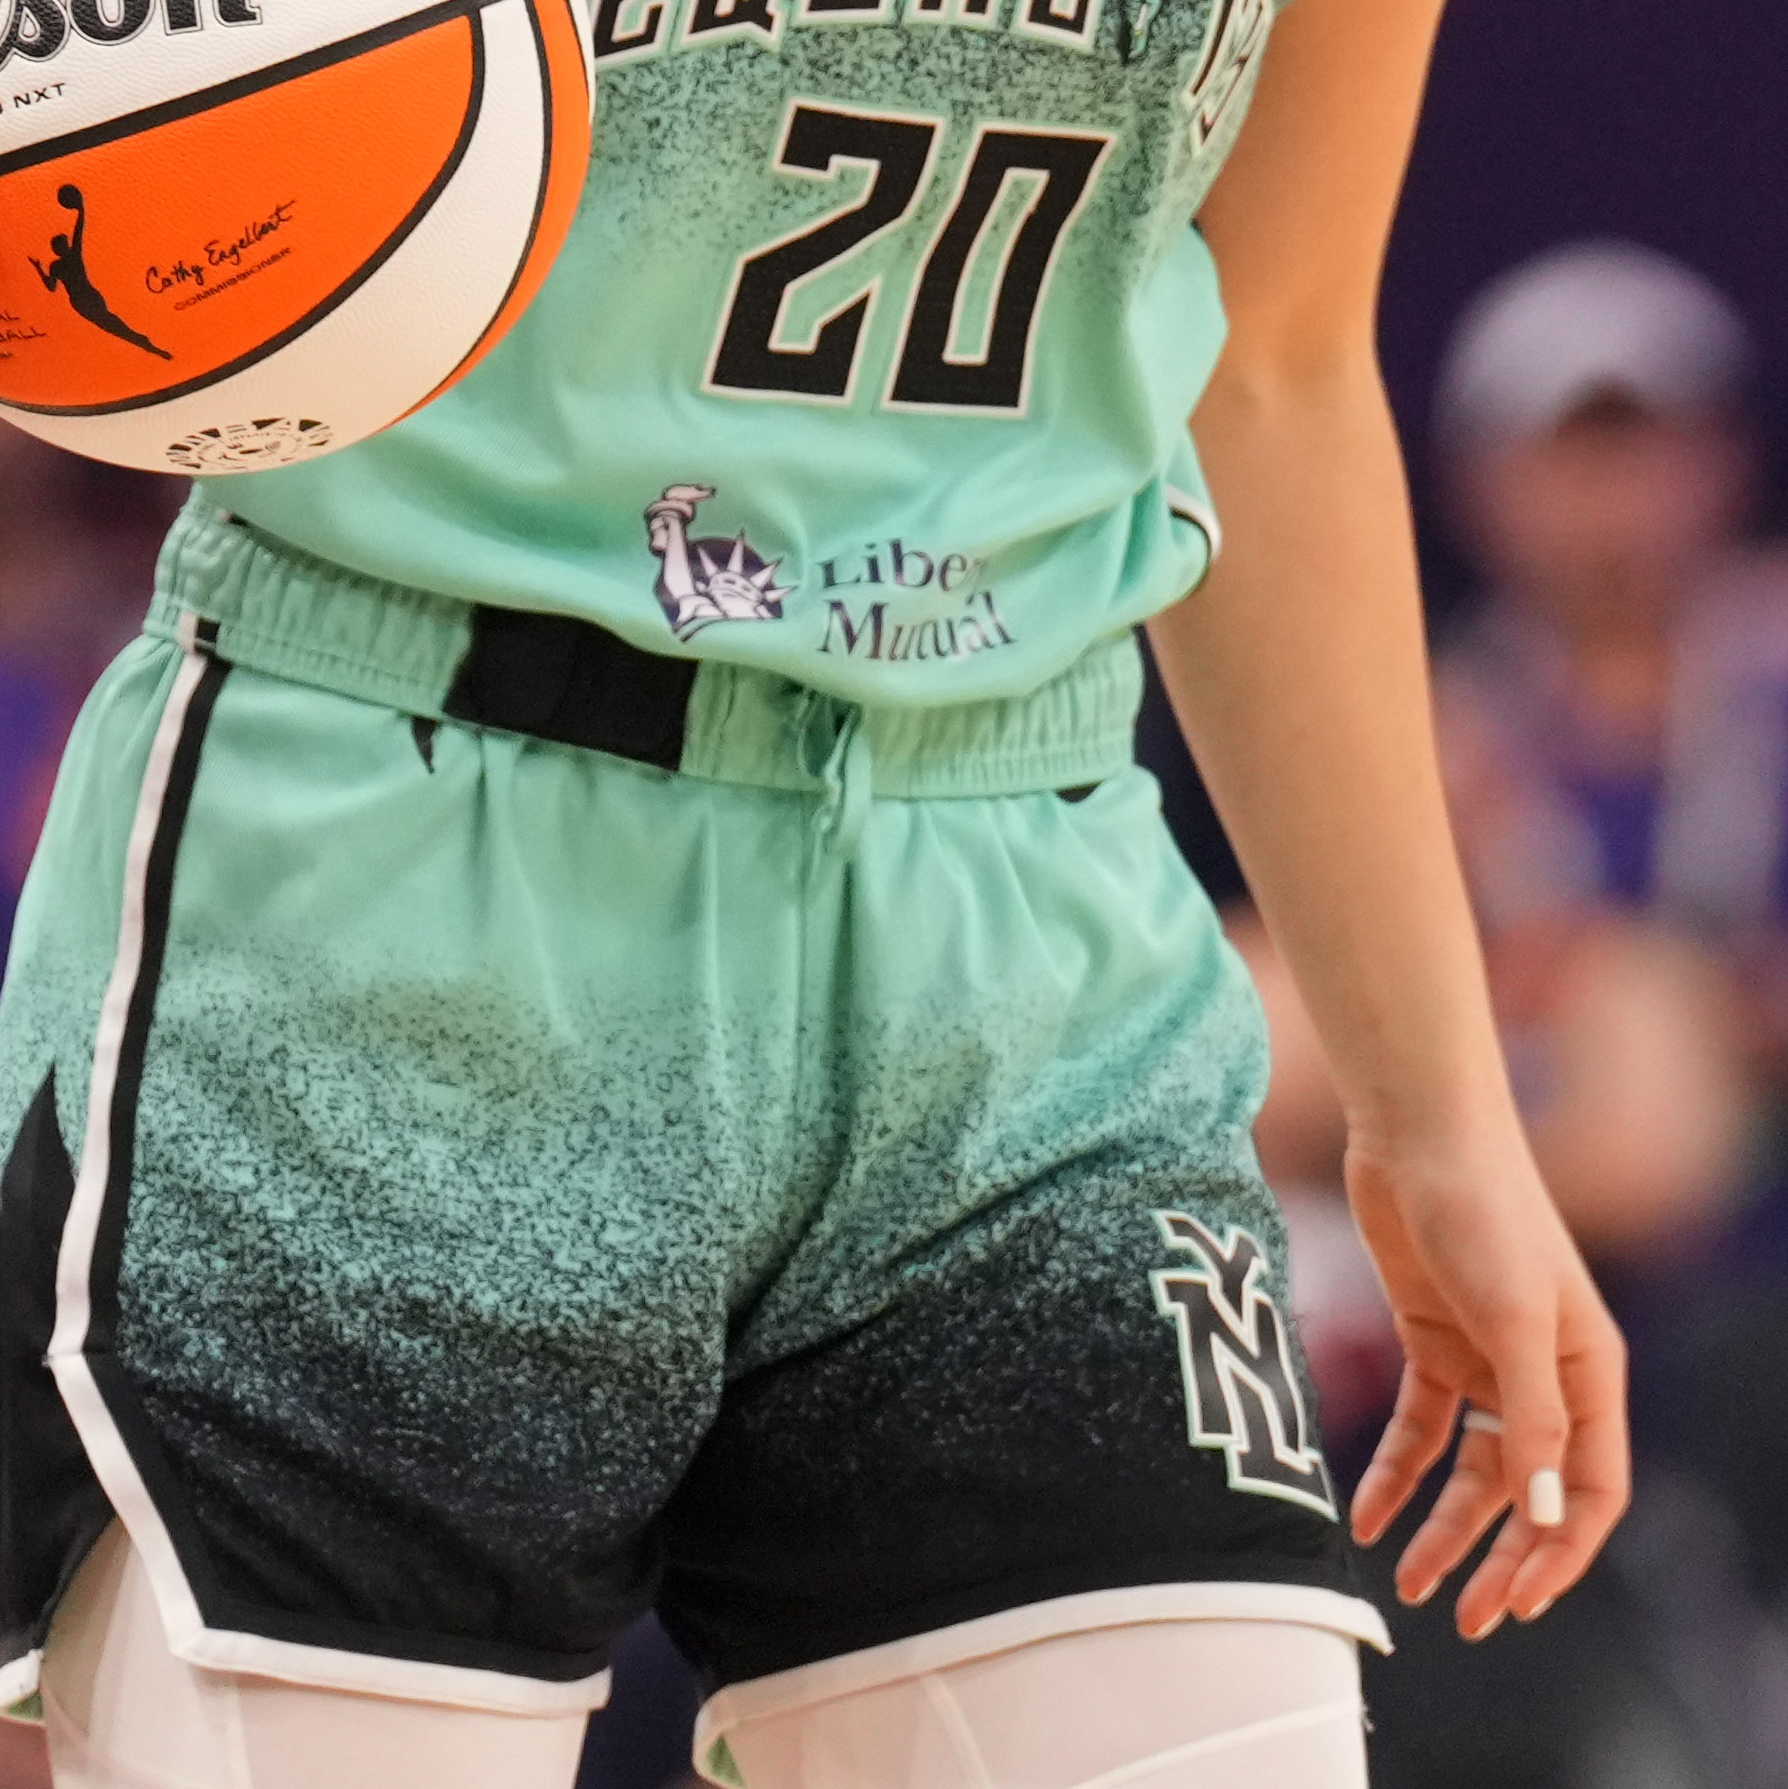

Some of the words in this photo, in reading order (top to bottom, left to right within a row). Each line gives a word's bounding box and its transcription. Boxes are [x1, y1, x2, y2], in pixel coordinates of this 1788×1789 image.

[13, 82, 67, 109] NXT
[146, 260, 205, 294] Cathy
[174, 247, 291, 311] COMMISSIONER
[703, 101, 1115, 417] 20
